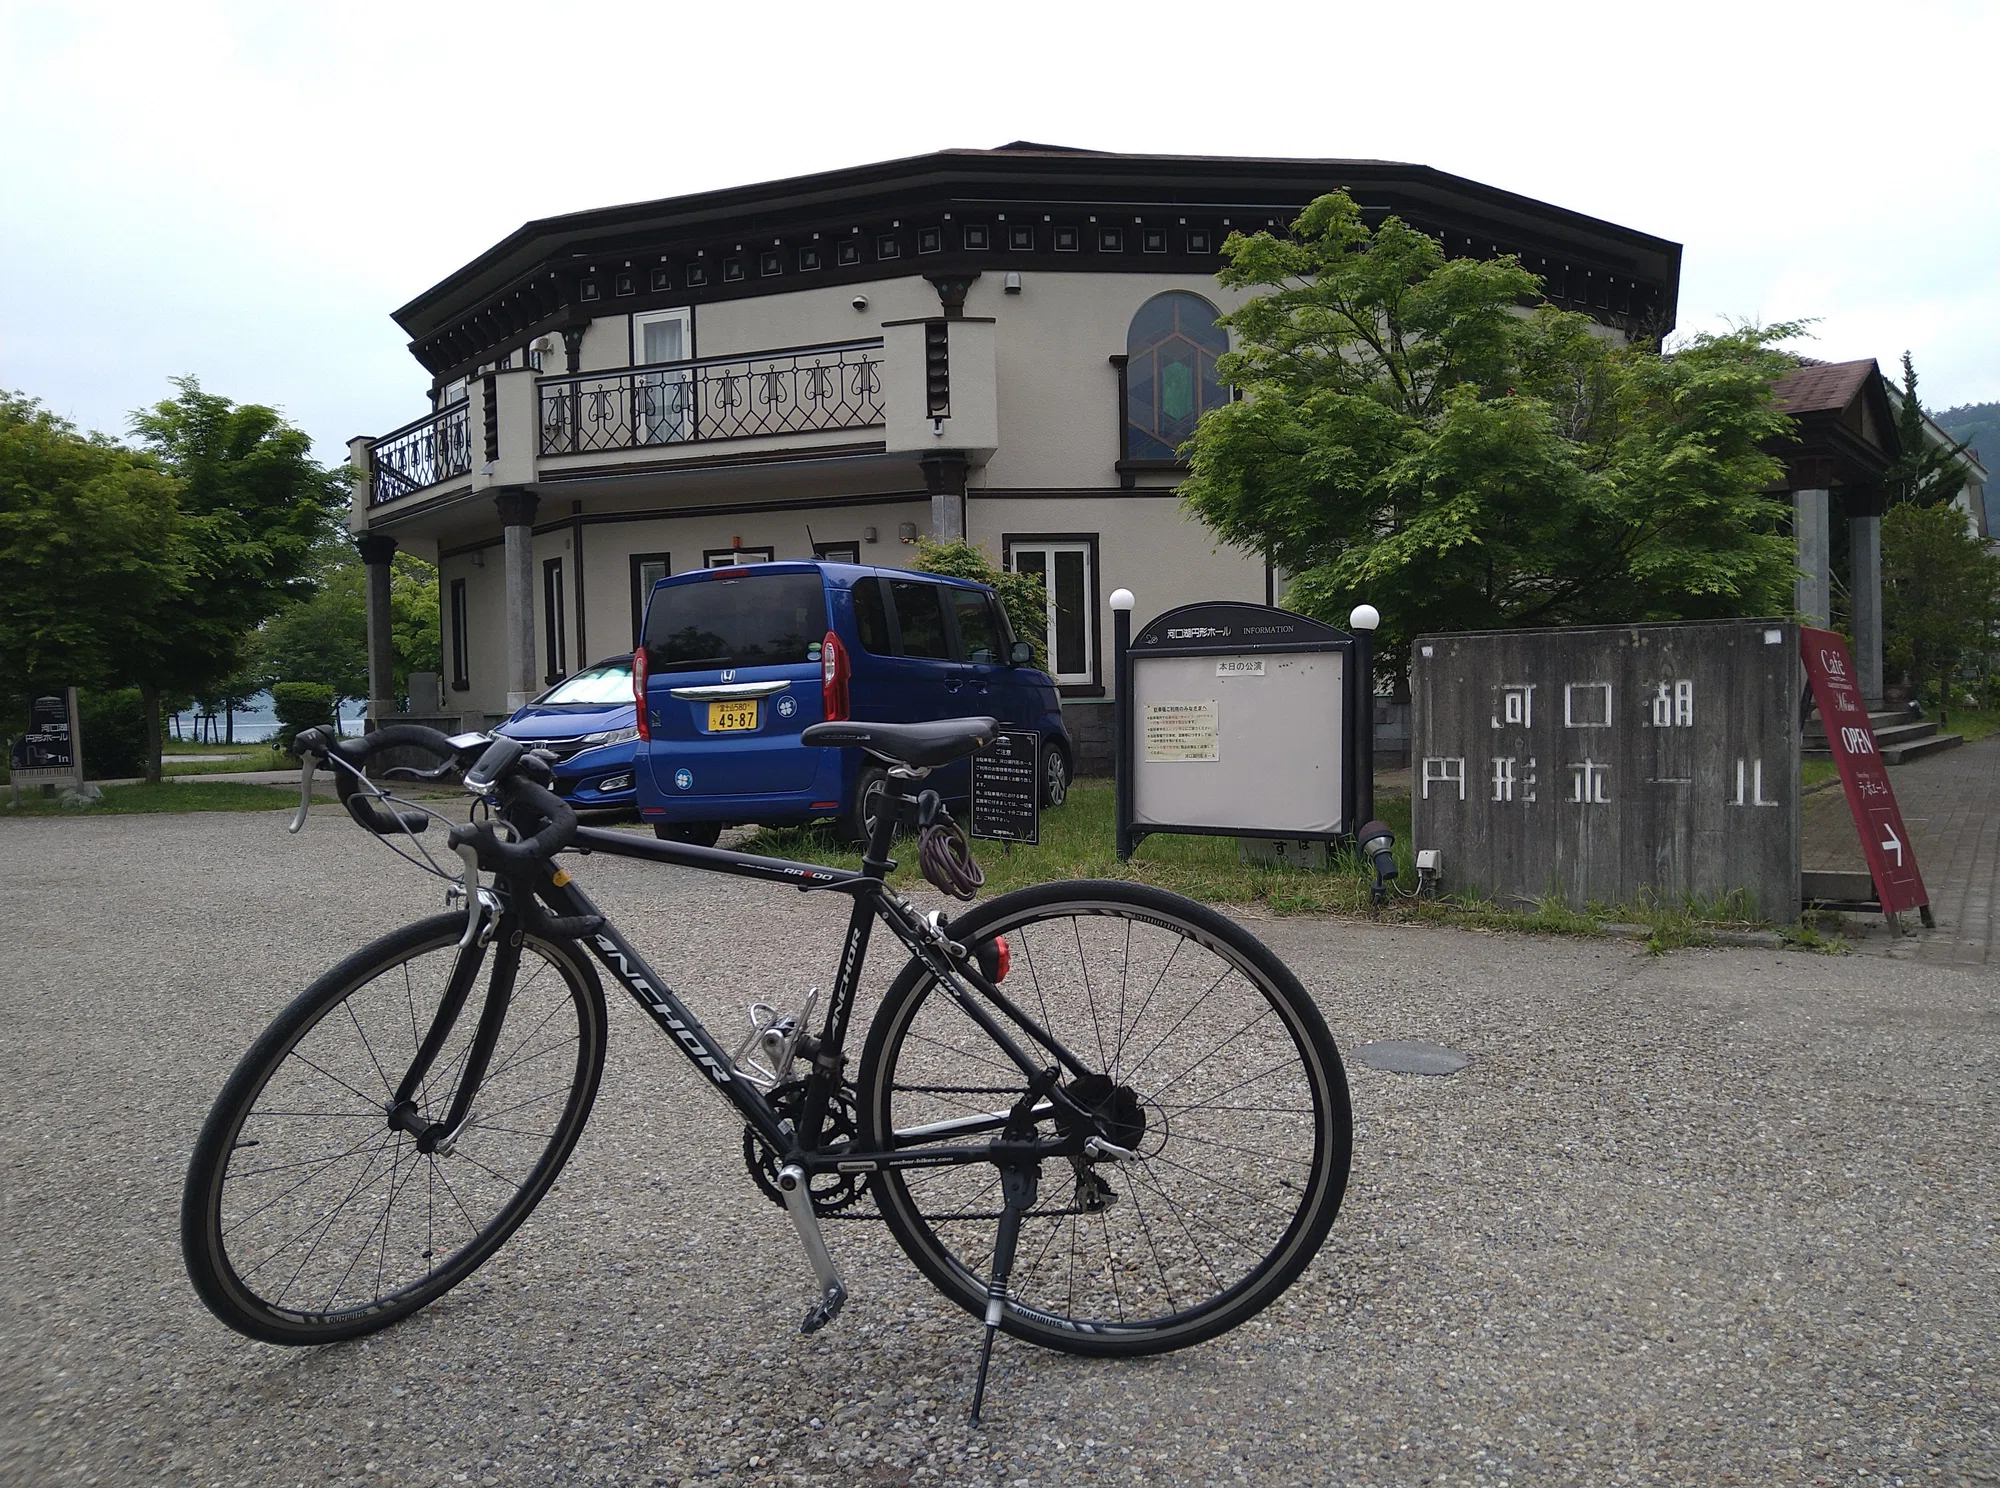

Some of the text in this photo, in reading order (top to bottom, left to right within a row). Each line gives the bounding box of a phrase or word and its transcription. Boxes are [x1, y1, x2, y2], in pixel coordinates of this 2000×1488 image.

[1167, 625, 1294, 639] 河口湖円形ホール INFORMATION
[1219, 661, 1263, 671] 本日の公演
[1820, 649, 1845, 676] Café
[1491, 679, 1693, 728] 河口湖
[41, 723, 68, 732] 河口湖
[719, 712, 755, 728] 49-87
[25, 733, 69, 743] 円形ホール
[1841, 726, 1874, 754] OPEN
[58, 755, 69, 763] In
[1422, 756, 1779, 807] 円形ホール
[900, 934, 961, 998] ANCHOR
[831, 927, 862, 1041] ANCHOR
[595, 933, 731, 1083] ANCHOR
[889, 1157, 954, 1167] anchor-bikes.com
